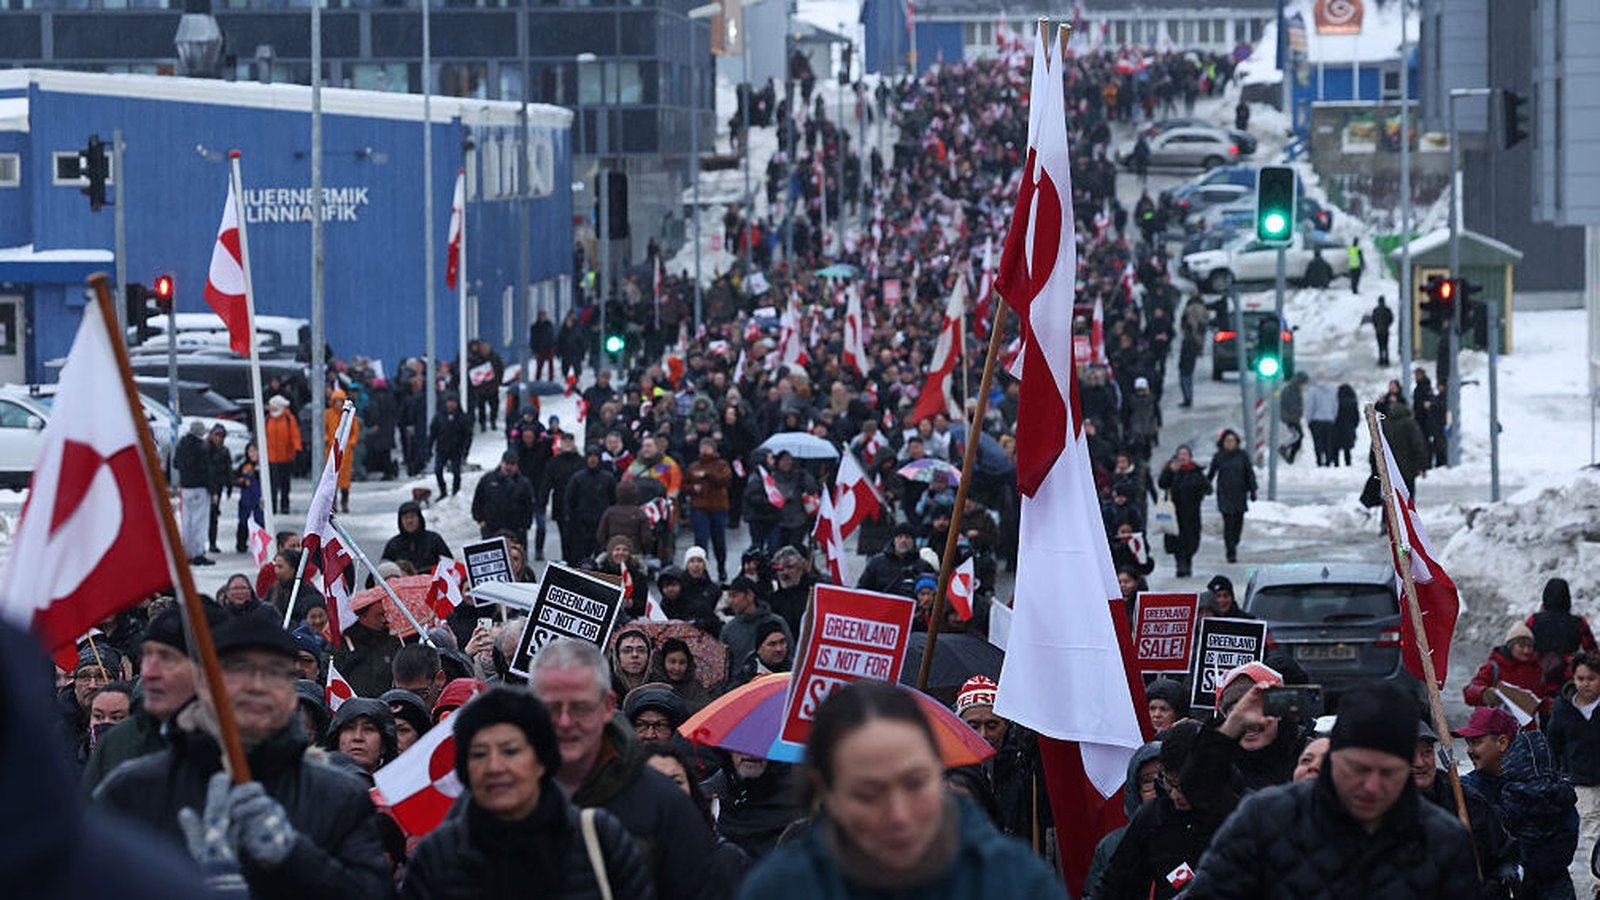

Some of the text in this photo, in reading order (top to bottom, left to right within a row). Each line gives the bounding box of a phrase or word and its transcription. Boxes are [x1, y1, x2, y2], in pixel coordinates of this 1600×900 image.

[548, 587, 605, 618] GREENLAND
[540, 606, 598, 639] IS NOT FOR
[1145, 608, 1190, 619] GREENLAND
[825, 617, 897, 646] GREENLAND
[1142, 623, 1187, 634] IS NOT FOR
[1140, 639, 1185, 658] SALE!
[1208, 635, 1255, 650] GREENLAND
[817, 648, 890, 678] IS NOT FOR
[1206, 652, 1215, 663] IS
[1217, 653, 1234, 664] NOT
